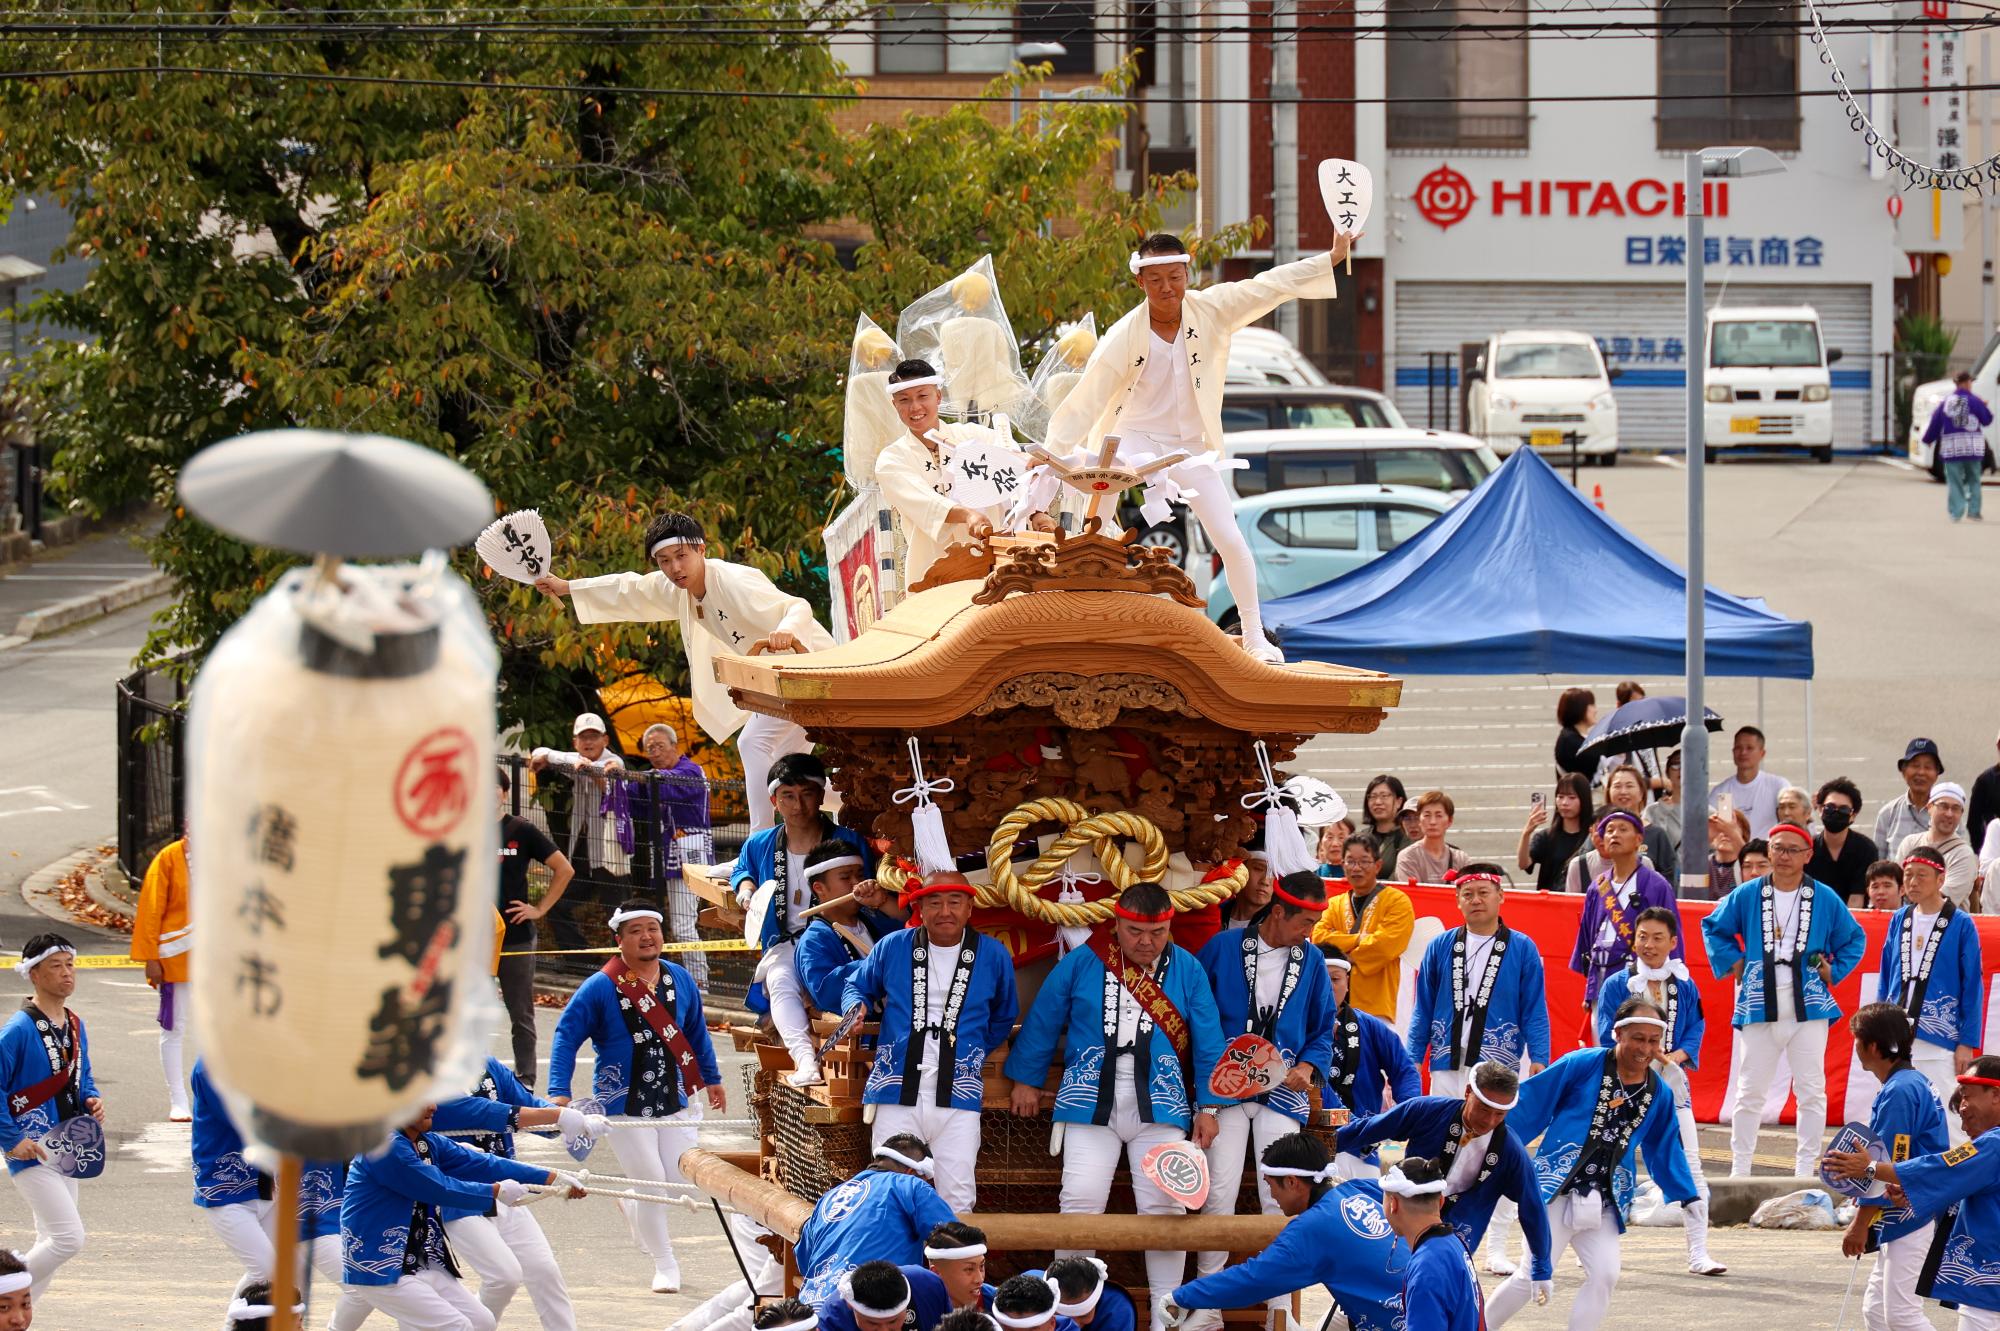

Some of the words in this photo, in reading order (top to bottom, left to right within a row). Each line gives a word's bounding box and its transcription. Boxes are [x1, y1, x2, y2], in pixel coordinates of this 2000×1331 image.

[1336, 166, 1358, 229] 大工方
[1491, 179, 1730, 217] HITACHI
[1624, 235, 1824, 268] 日栄電気商会
[913, 966, 927, 1033] 東家若連中
[1589, 1075, 1614, 1140] 東家若連中
